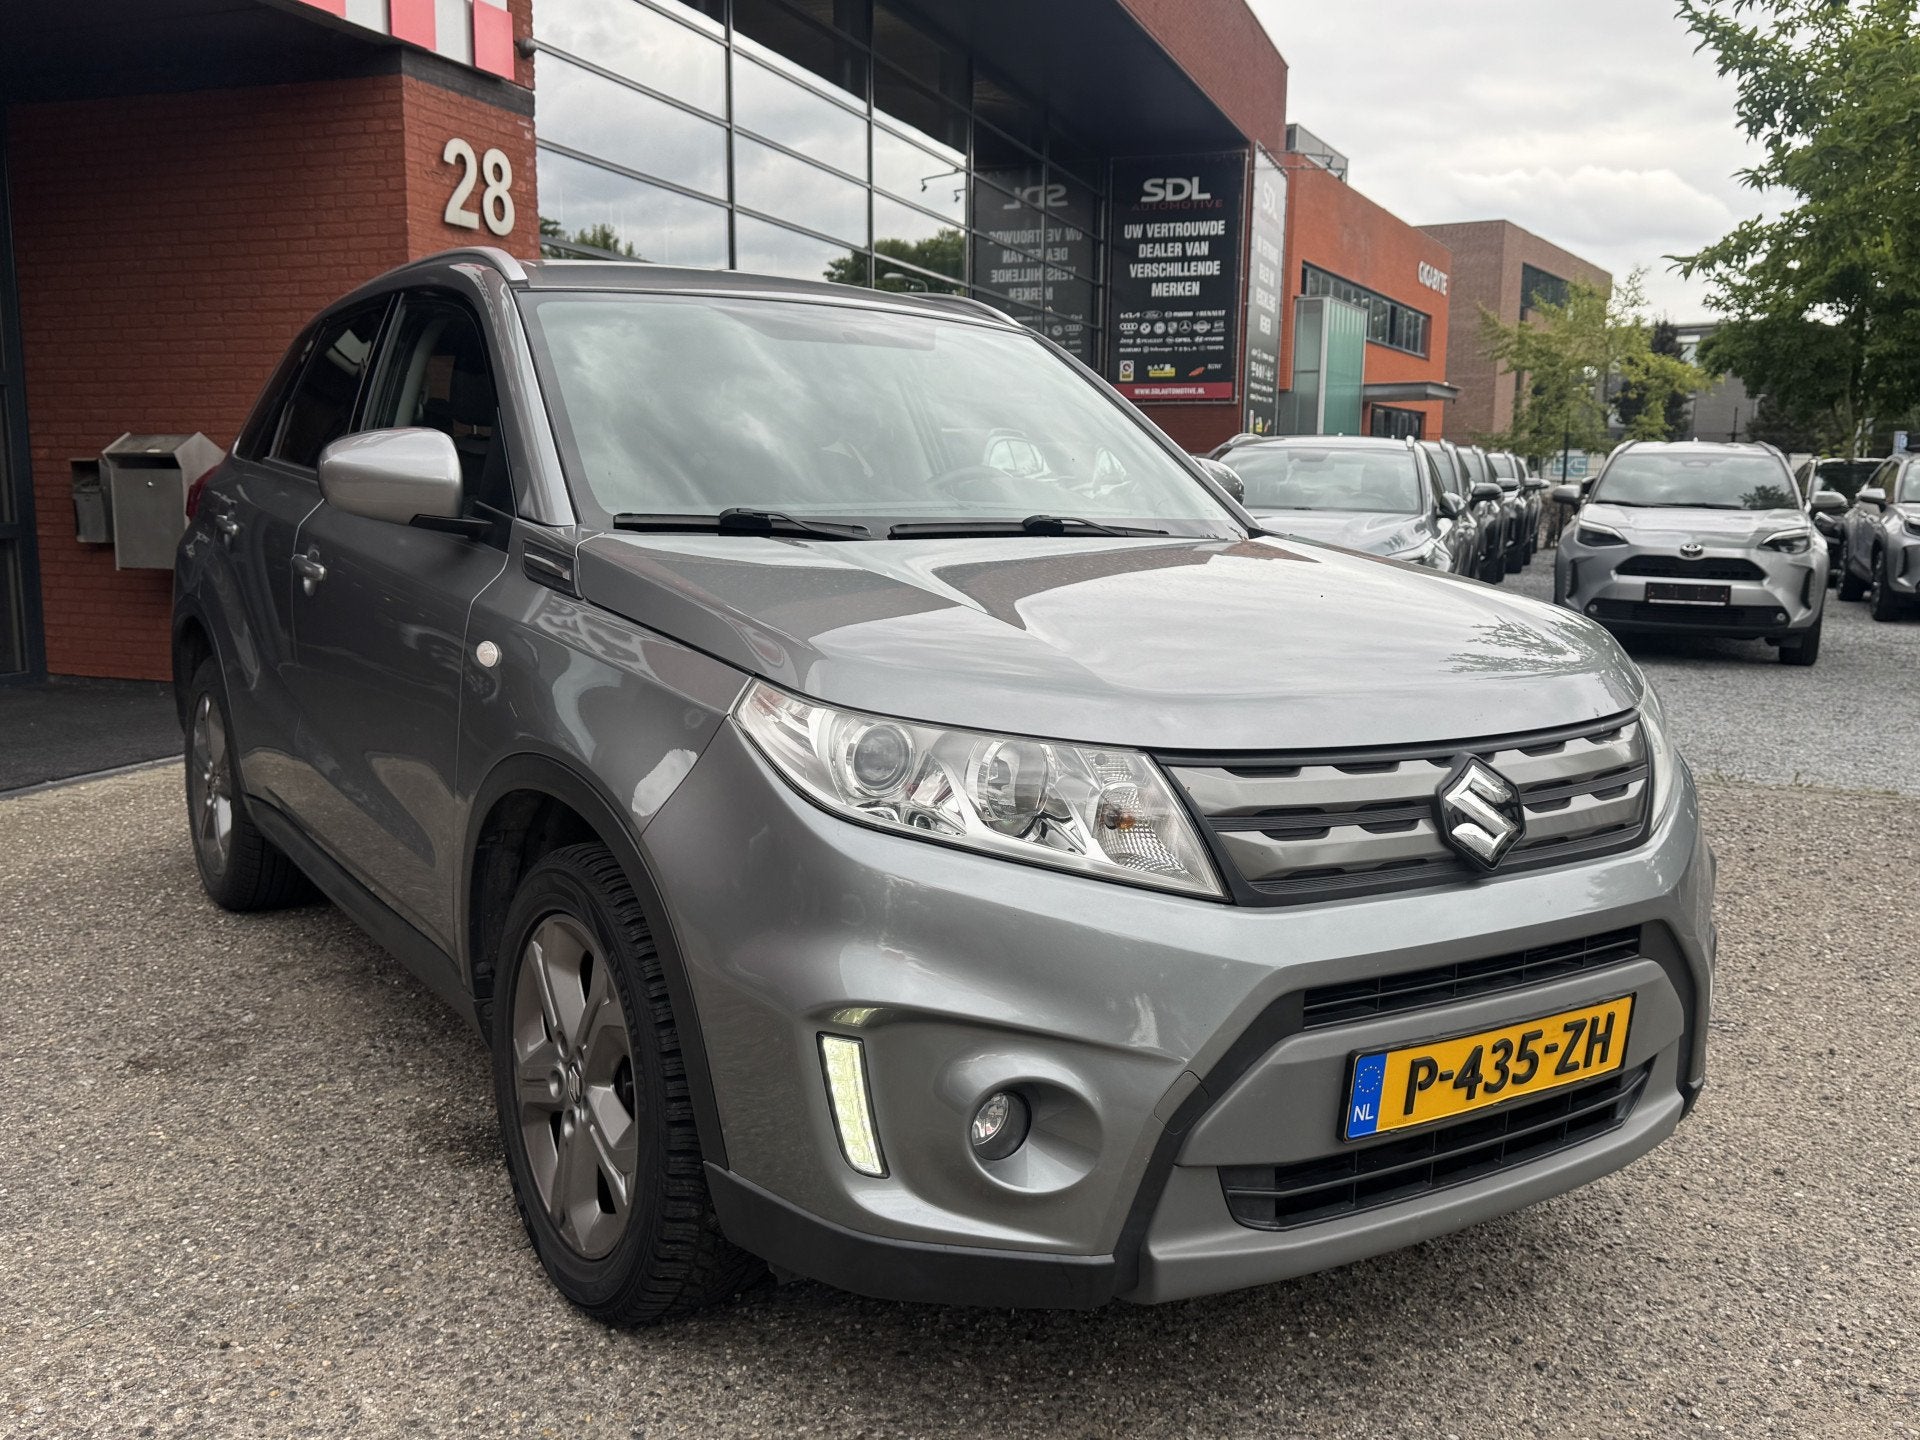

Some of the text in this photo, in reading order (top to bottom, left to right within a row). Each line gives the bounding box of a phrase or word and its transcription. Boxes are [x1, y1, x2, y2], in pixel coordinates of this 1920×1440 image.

[443, 138, 515, 236] 28
[1140, 177, 1211, 203] SDL
[1131, 200, 1223, 212] AUTOMOTIVE
[1124, 220, 1226, 239] UW VERTROUWDE
[1138, 241, 1209, 258] DEALER VAN
[1129, 261, 1221, 278] VERSCHILLENDE
[1151, 281, 1200, 297] MERKEN
[1353, 1011, 1616, 1123] NL P-435-ZH
